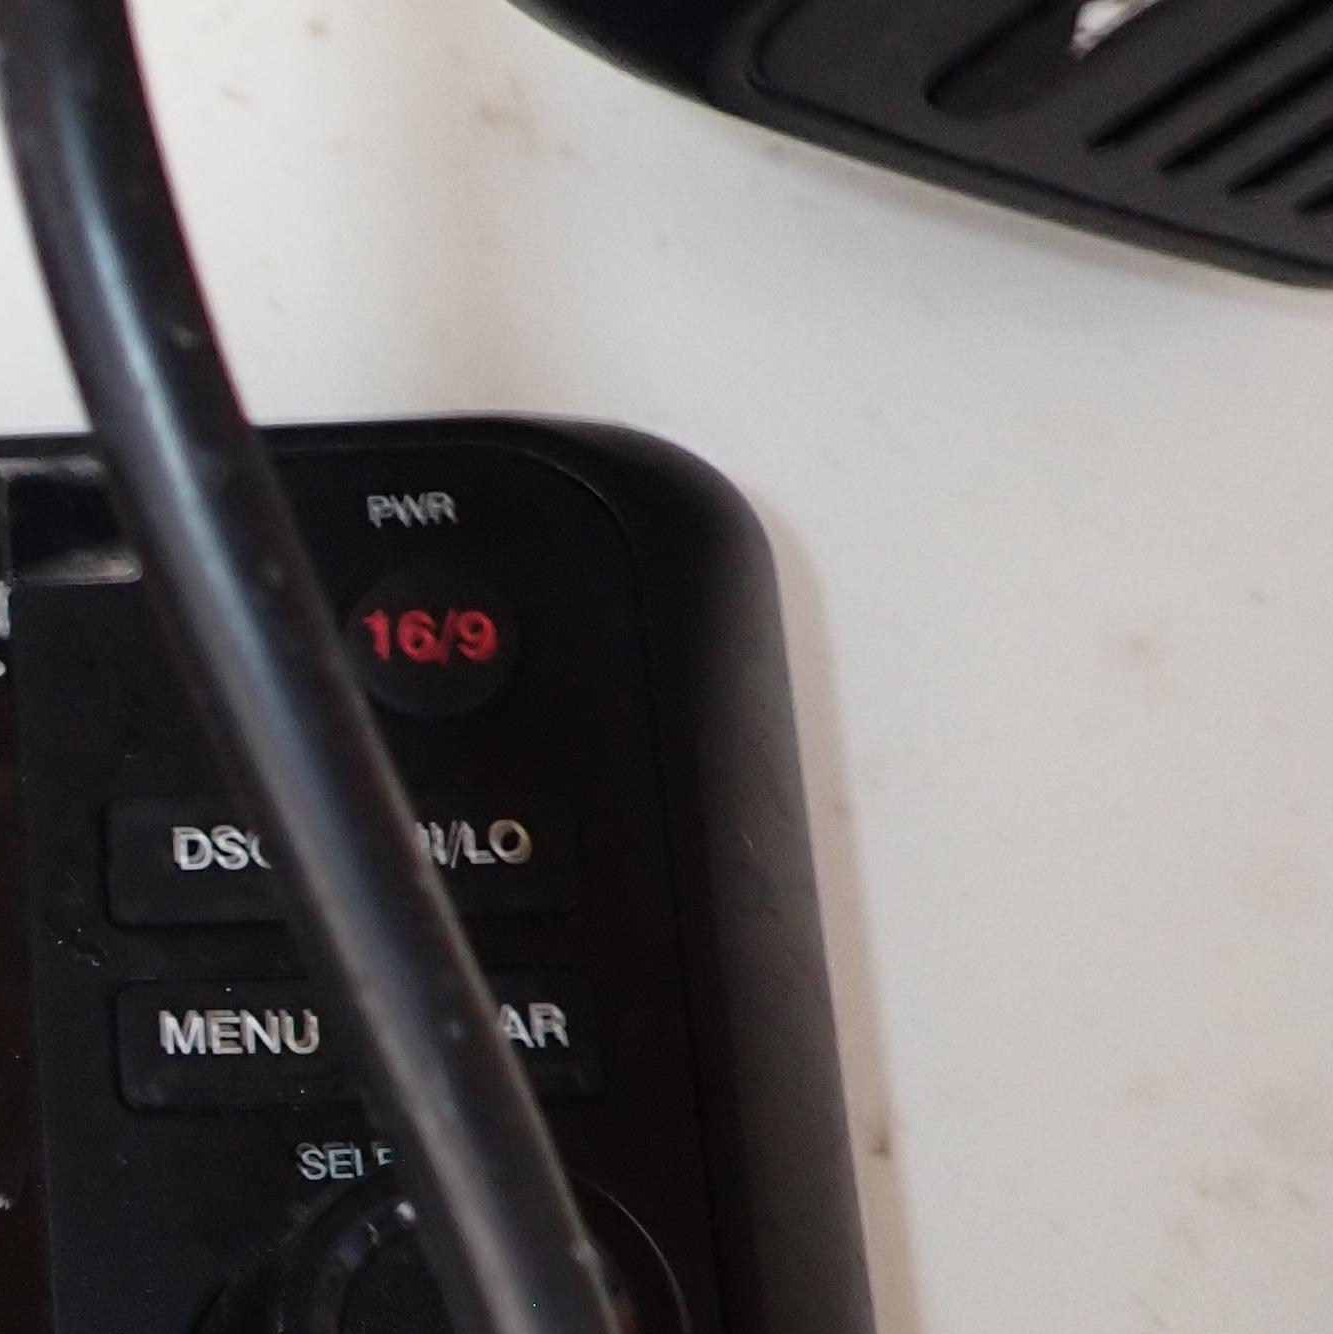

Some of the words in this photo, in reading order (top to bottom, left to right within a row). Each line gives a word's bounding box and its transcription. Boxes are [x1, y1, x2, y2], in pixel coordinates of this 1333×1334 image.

[366, 491, 459, 528] PWR
[363, 609, 500, 664] 16/9
[159, 1008, 320, 1055] MENU
